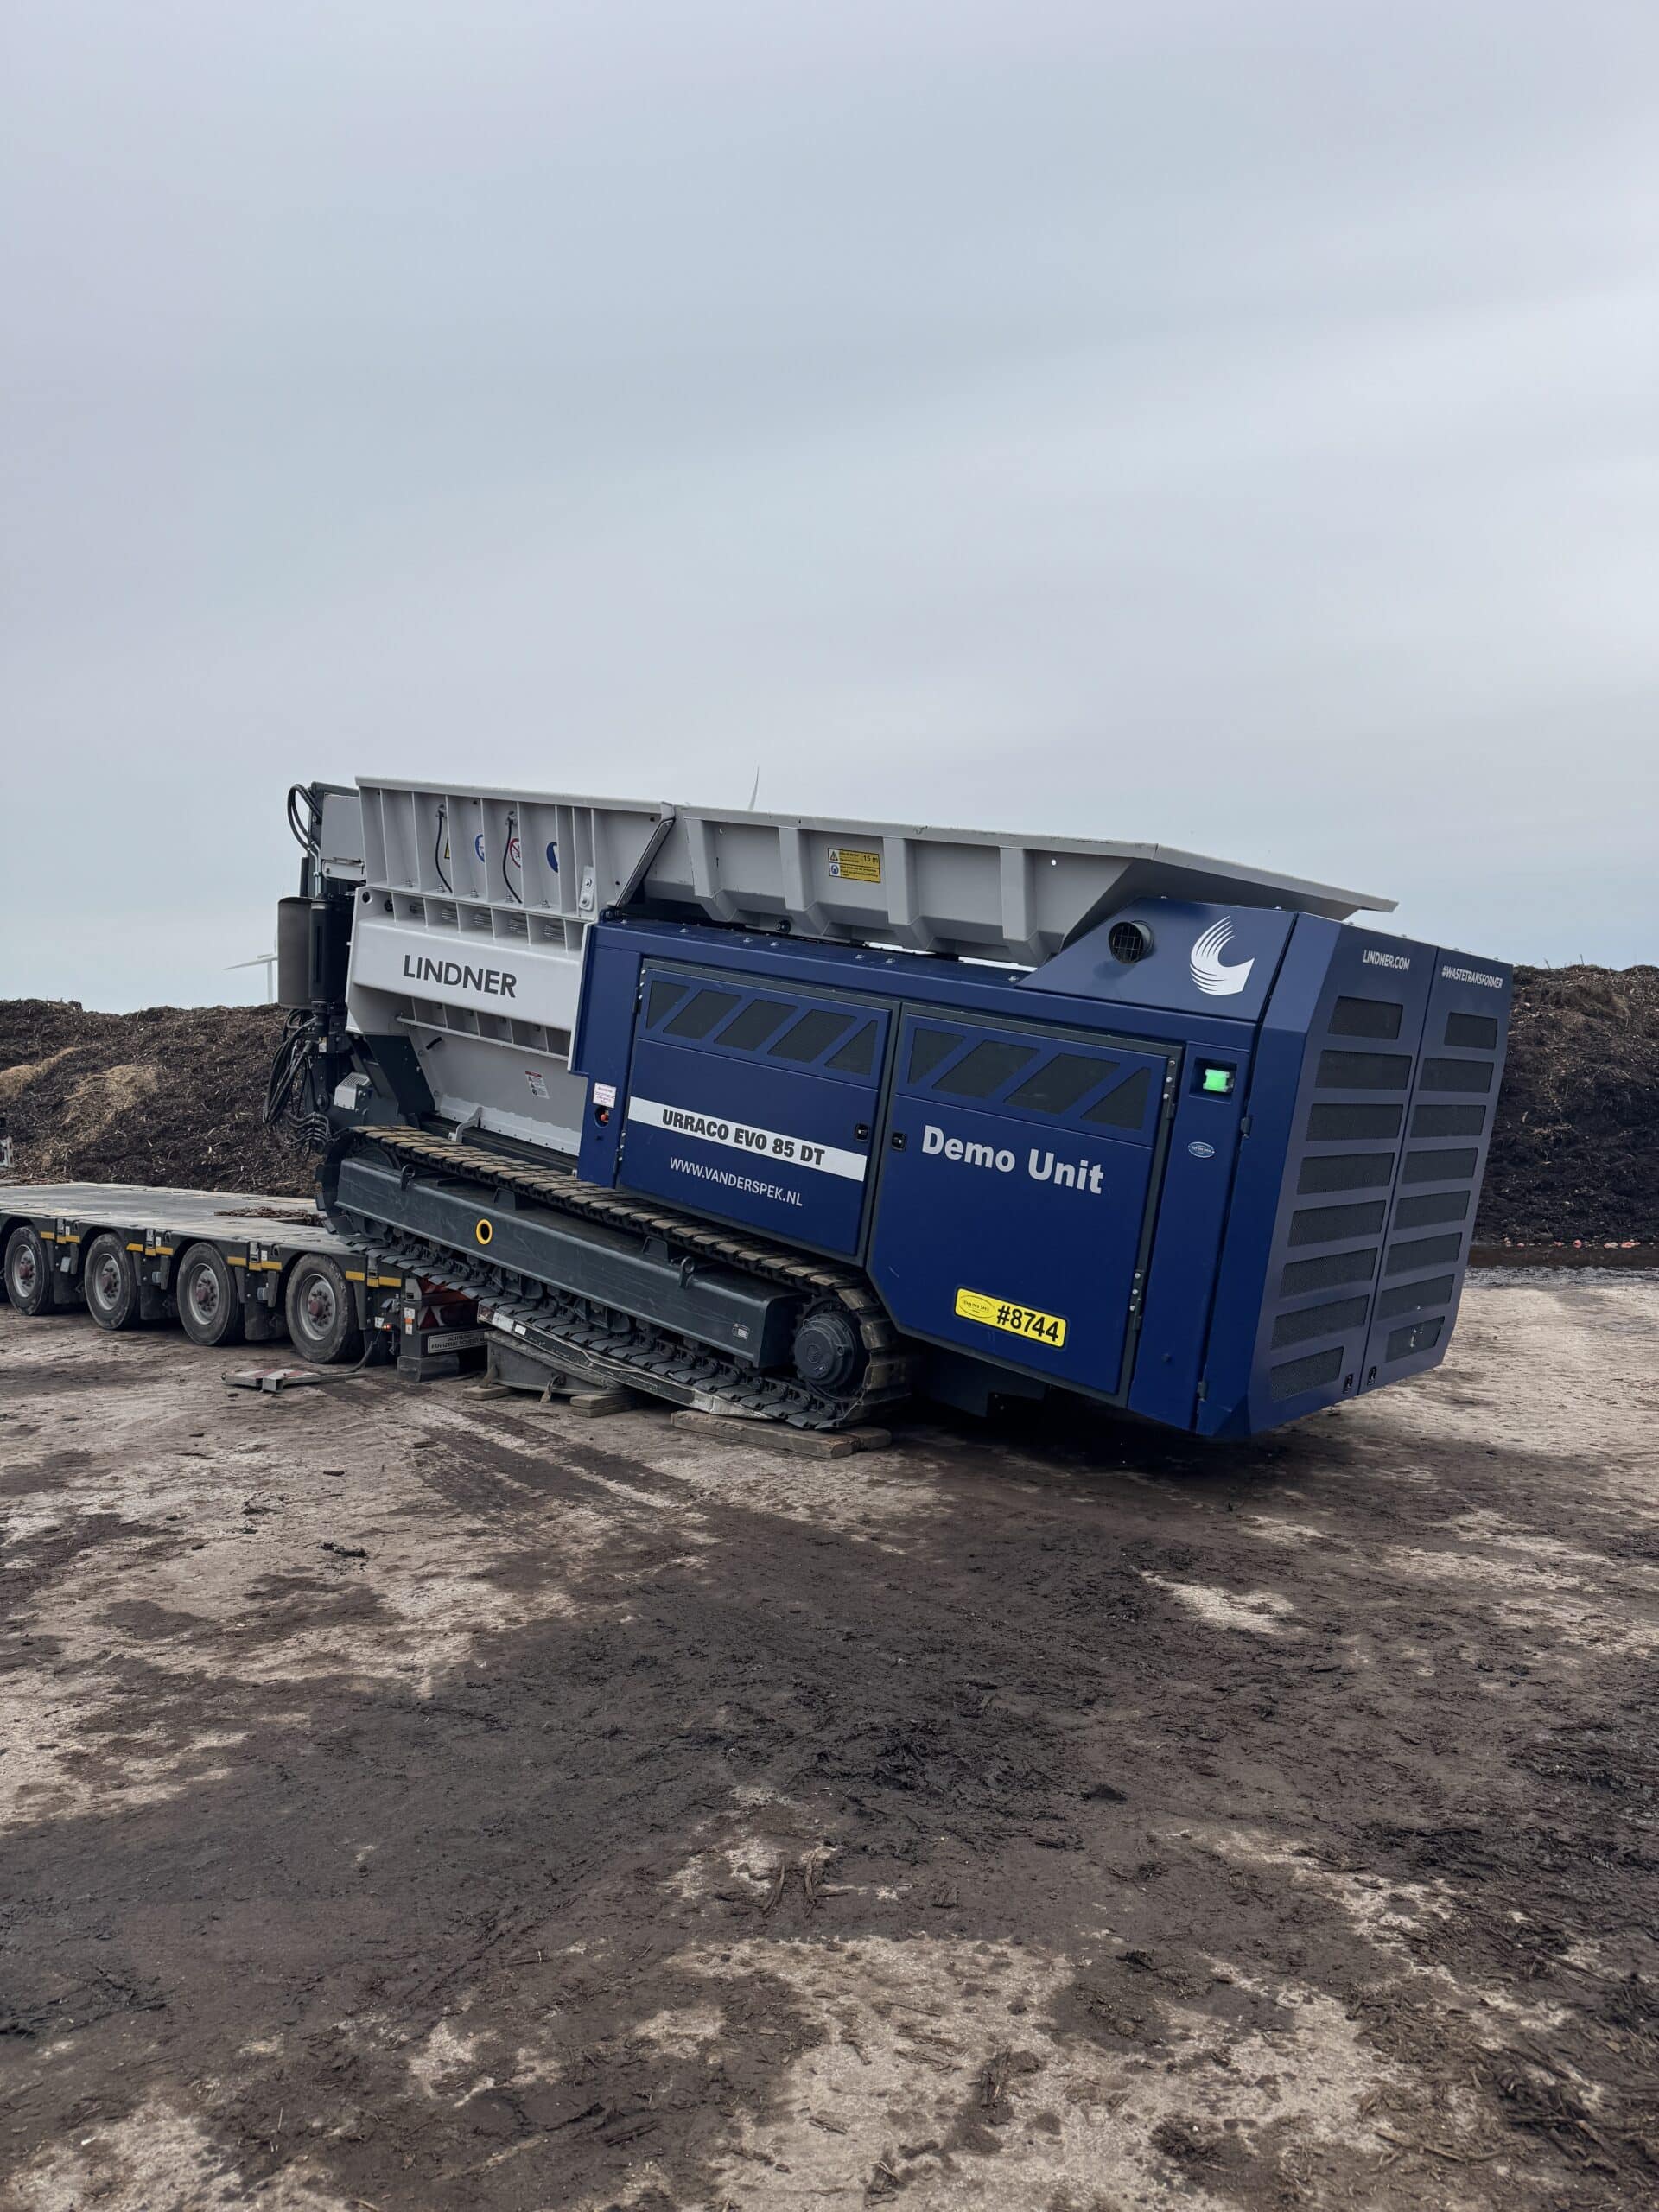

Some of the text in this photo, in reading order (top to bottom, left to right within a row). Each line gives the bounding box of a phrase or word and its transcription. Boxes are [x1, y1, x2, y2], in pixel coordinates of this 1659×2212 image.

[403, 954, 517, 998] LINDNER
[1362, 949, 1411, 971] LINDNER.COM
[1441, 964, 1504, 989] #WASTETRANSFORMER
[662, 1109, 826, 1166] URRACO EVO 85 DT
[669, 1156, 803, 1207] WWW.VANDERSPEK.NL
[921, 1125, 1104, 1195] Demo Unit
[996, 1304, 1059, 1342] #8744
